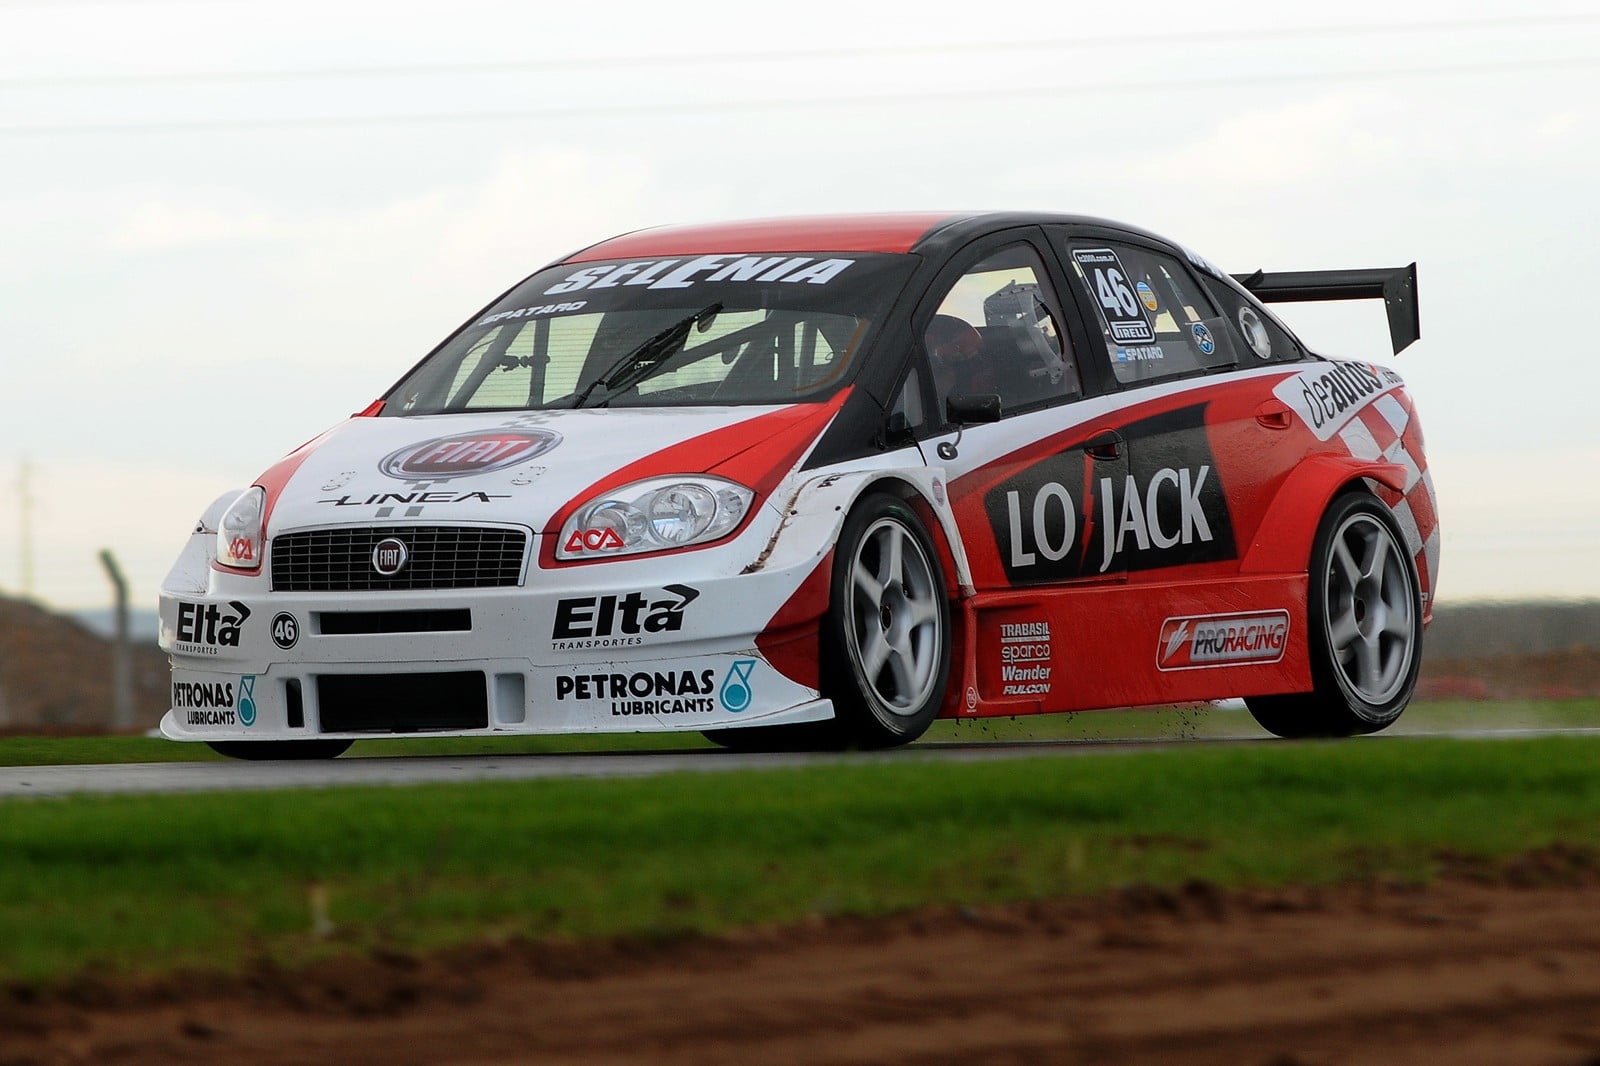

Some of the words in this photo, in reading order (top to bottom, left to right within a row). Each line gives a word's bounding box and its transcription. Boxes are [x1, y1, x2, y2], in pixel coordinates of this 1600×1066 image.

[544, 253, 856, 295] SELENIA
[1094, 267, 1139, 317] 46
[478, 301, 588, 326] SPATARO
[1110, 321, 1151, 339] PIRELLI
[1125, 346, 1164, 361] SPATARO
[412, 439, 530, 465] FIAT
[317, 491, 512, 506] LINEA
[1099, 465, 1214, 573] JACK
[379, 548, 400, 567] FIAT
[176, 601, 243, 648] Elta
[551, 588, 690, 640] Elta
[274, 620, 296, 642] 46
[1000, 622, 1051, 637] TRABASIL
[1194, 623, 1287, 655] PRORACING
[176, 643, 218, 655] TRANSPORTES
[552, 636, 643, 651] TRANSPORTES
[1001, 644, 1051, 664] sparco
[1001, 664, 1052, 682] Wander
[173, 682, 234, 708] PETRONAS
[556, 669, 715, 701] PETRONAS
[611, 697, 714, 716] LUBRICANTS
[187, 710, 236, 726] LUBRICANTS
